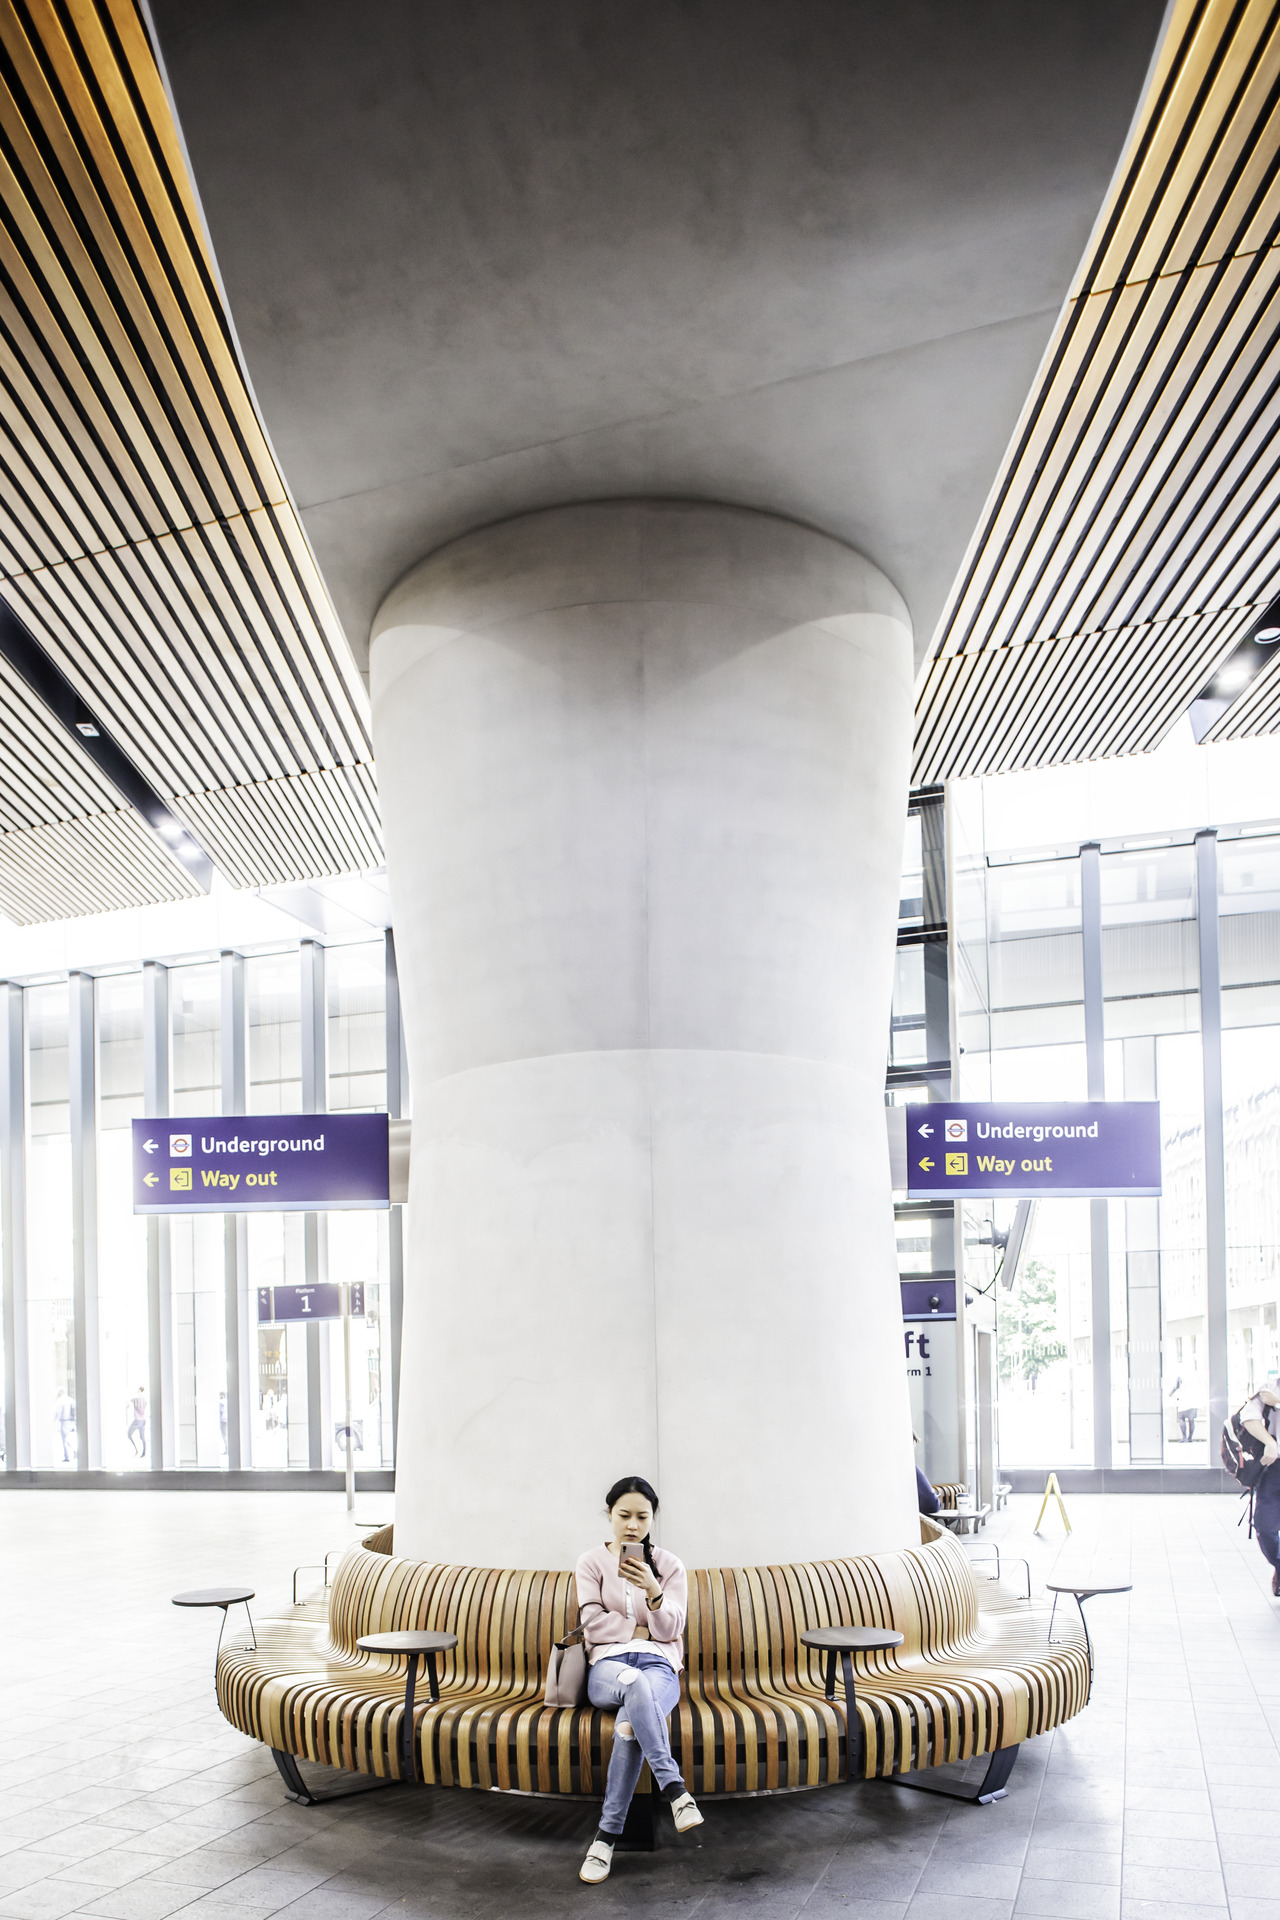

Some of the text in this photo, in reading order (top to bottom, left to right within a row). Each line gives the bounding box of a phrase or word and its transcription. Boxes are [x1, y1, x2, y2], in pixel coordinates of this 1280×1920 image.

[976, 1121, 1099, 1142] Underground
[201, 1134, 325, 1156] Underground
[976, 1155, 1053, 1176] Way out
[200, 1170, 278, 1190] Way out
[301, 1295, 312, 1313] 1
[904, 1331, 930, 1359] ft
[925, 1366, 932, 1376] 1
